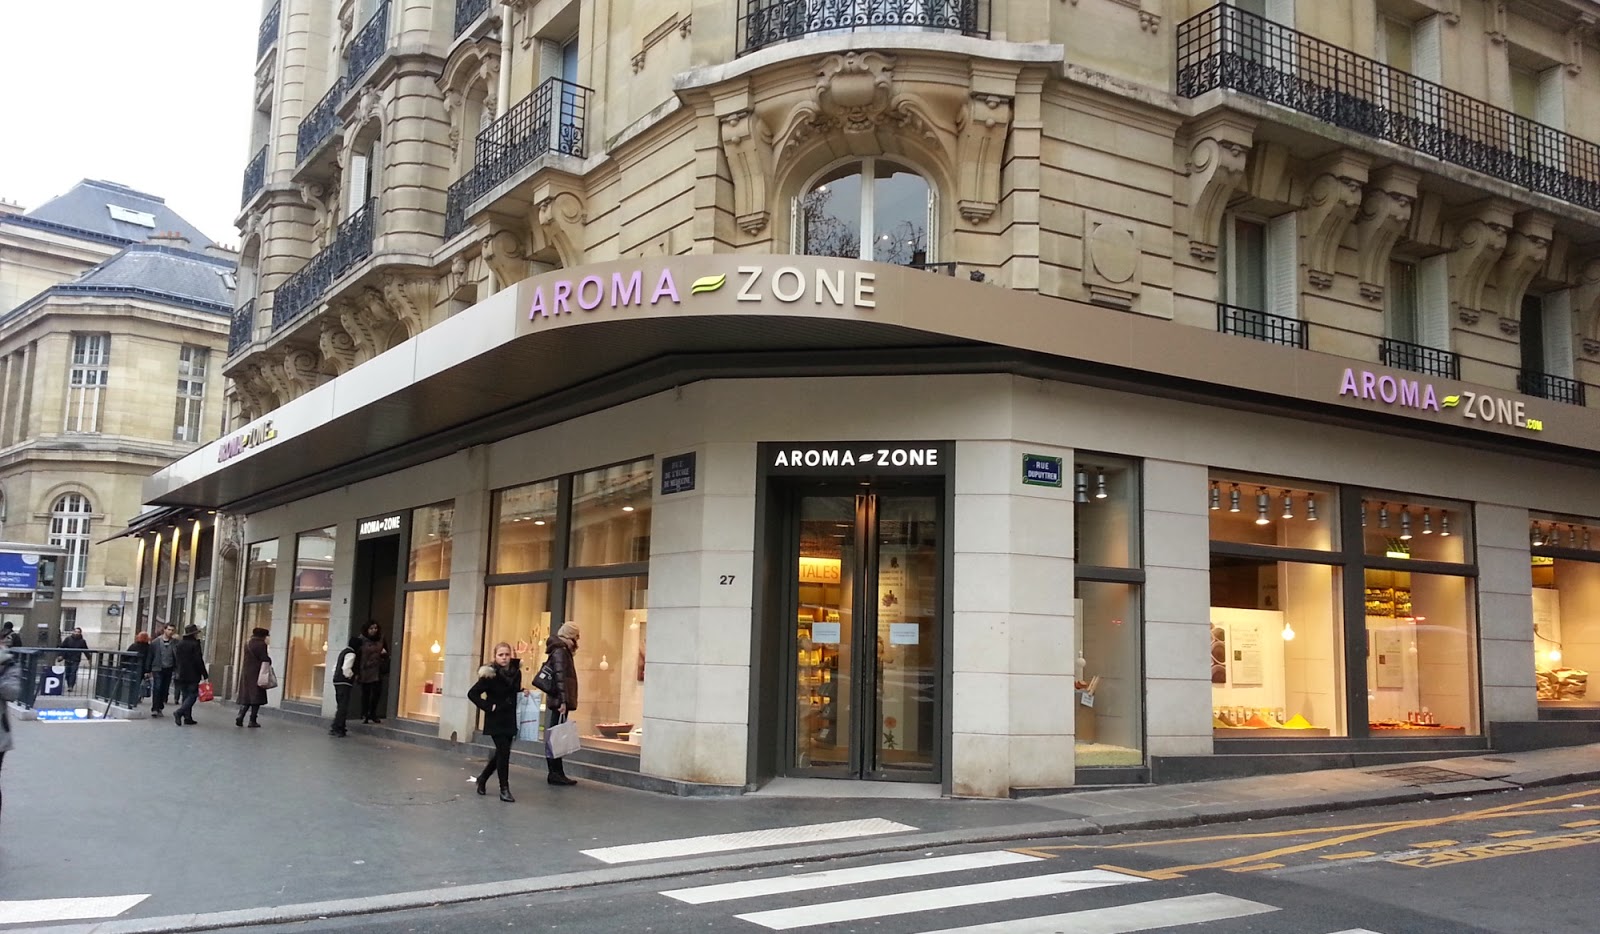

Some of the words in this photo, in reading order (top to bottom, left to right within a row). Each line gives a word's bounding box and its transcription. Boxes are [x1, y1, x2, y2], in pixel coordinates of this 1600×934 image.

[528, 268, 681, 321] AROMA
[736, 265, 876, 308] ZONE
[1339, 368, 1439, 412] AROMA
[1463, 391, 1526, 428] ZONE
[774, 450, 855, 467] AROMA
[877, 449, 938, 466] ZONE
[1035, 461, 1050, 470] RUE
[1027, 470, 1057, 480] DUPUYTREN
[360, 519, 380, 535] AROMA
[383, 515, 401, 531] ZONE
[719, 574, 736, 585] 27
[44, 676, 60, 694] P
